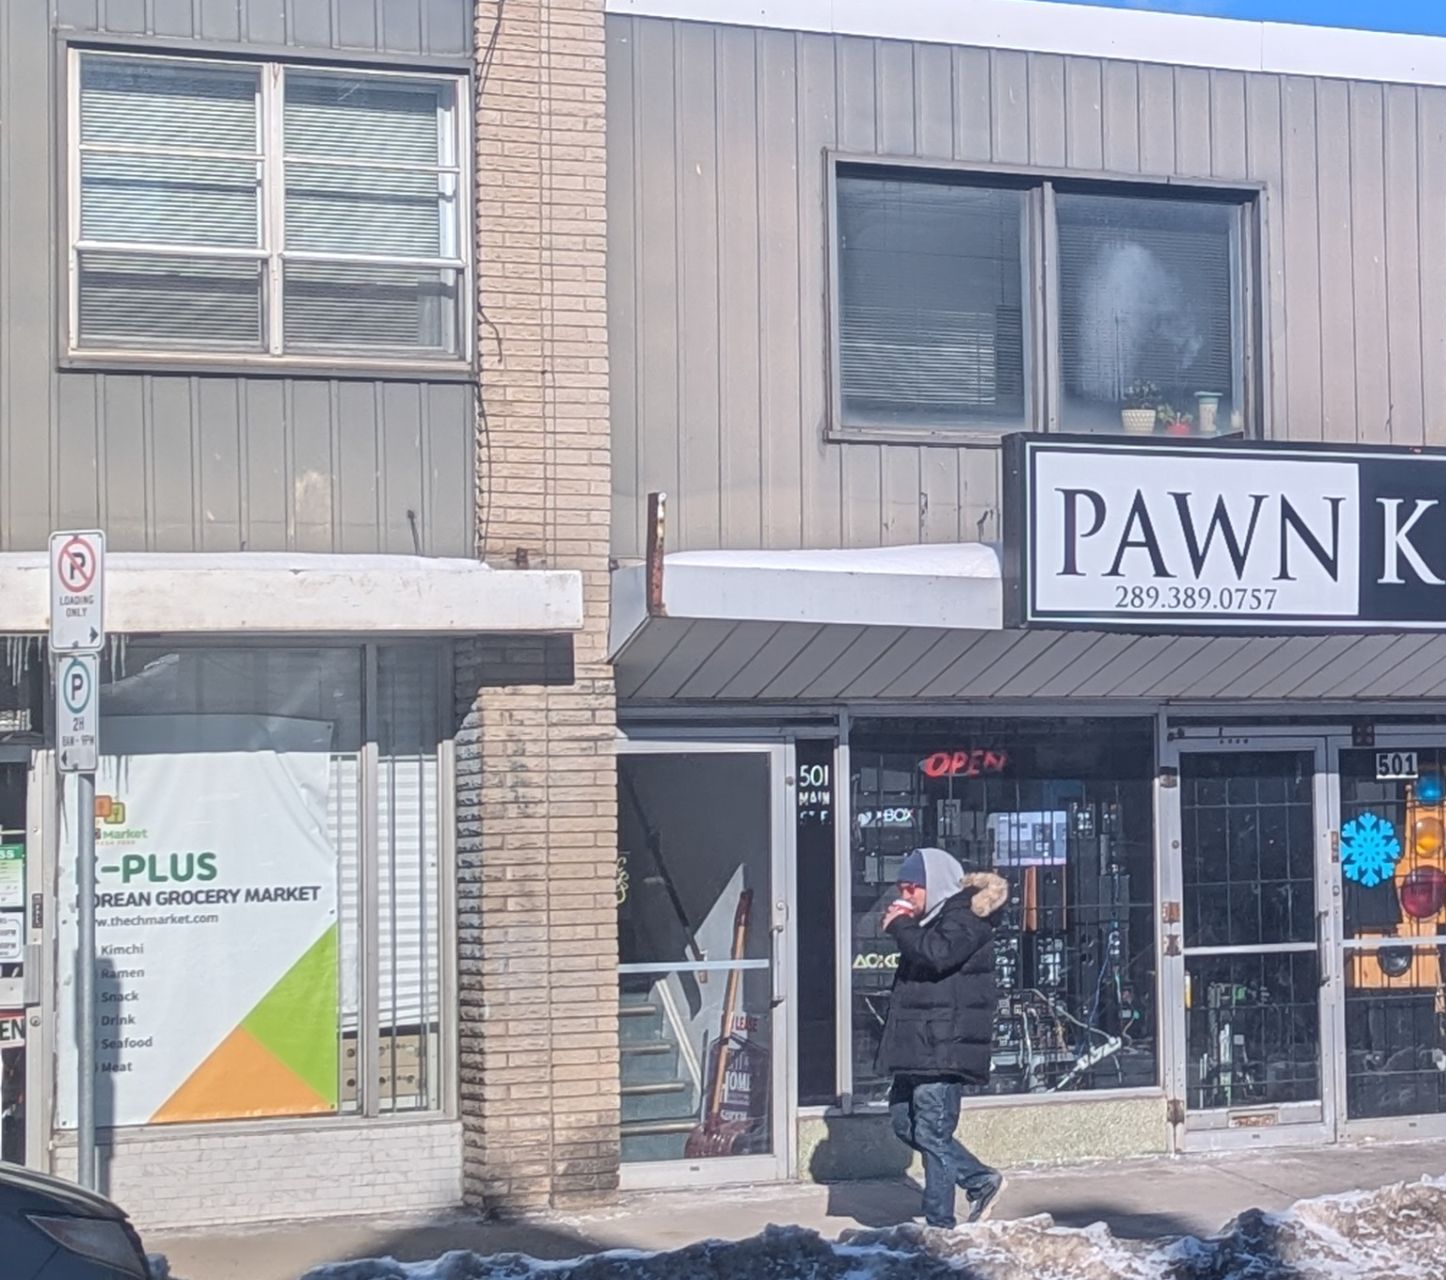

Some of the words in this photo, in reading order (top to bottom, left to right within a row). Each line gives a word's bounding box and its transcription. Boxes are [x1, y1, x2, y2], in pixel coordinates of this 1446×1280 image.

[1054, 488, 1347, 582] PAWN
[59, 595, 94, 606] LOADING
[1115, 585, 1277, 610] 289.389.0757
[66, 607, 87, 617] ONLY
[922, 750, 1007, 777] OPEN
[1378, 754, 1416, 776] 501
[800, 765, 829, 787] 501
[799, 791, 830, 806] MAIN
[103, 828, 148, 840] Market
[76, 891, 150, 909] REAN
[155, 888, 241, 906] GROCERY
[244, 886, 321, 903] MARKET
[76, 913, 218, 927] w.thechmarket.com
[101, 943, 144, 955] Kimchi
[102, 968, 145, 979] Ramen
[102, 990, 139, 1003] Snack
[102, 1014, 136, 1026] Drink
[102, 1036, 153, 1050] Seafood
[102, 1062, 133, 1072] Meat
